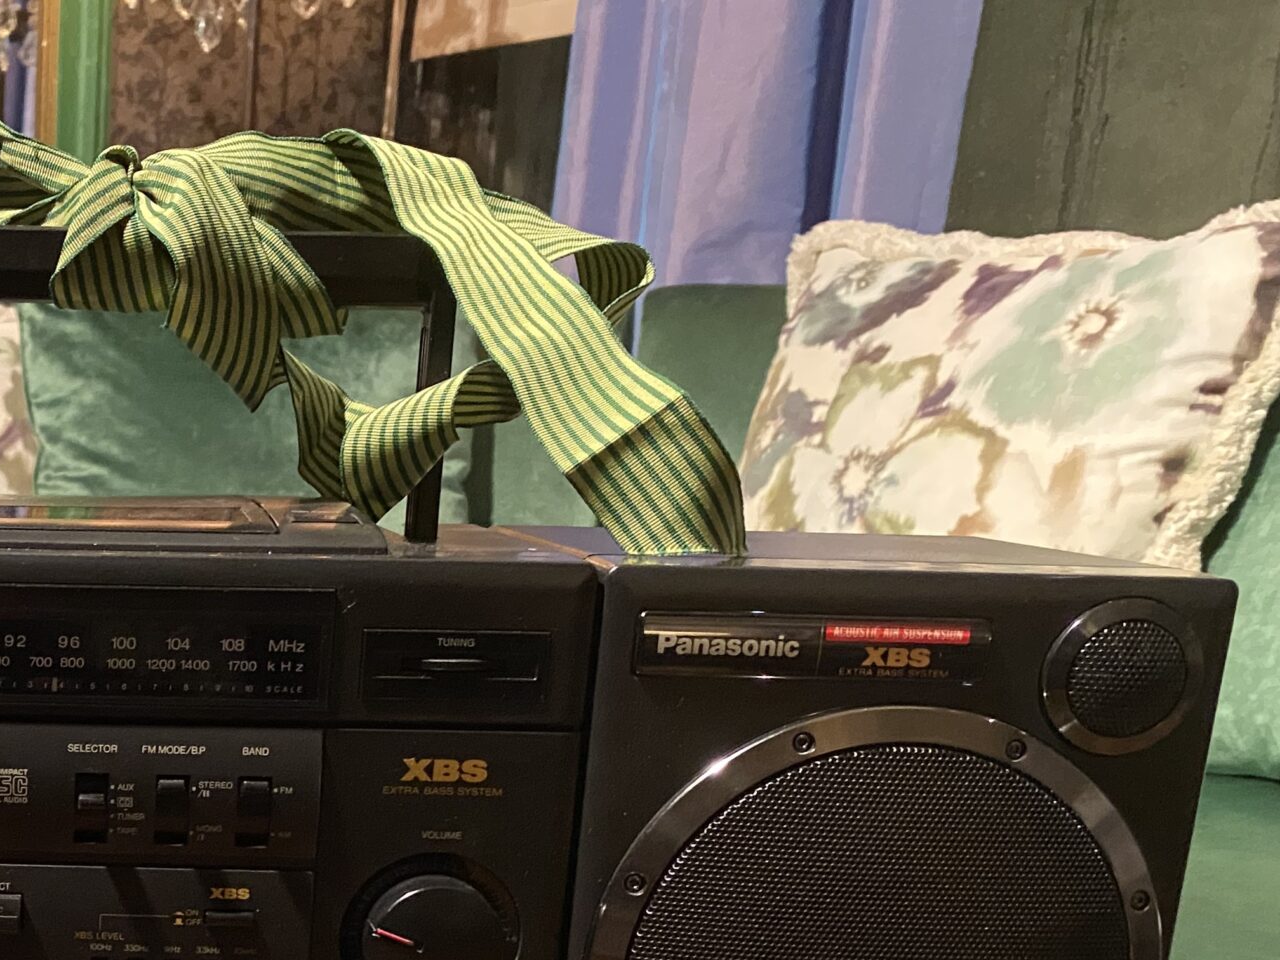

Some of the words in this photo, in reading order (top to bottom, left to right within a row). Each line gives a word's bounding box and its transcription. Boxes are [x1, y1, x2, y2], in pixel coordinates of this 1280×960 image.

[833, 626, 880, 638] ACOUSTIC
[883, 627, 900, 639] AIR
[903, 628, 964, 641] SUSPENSION
[4, 634, 26, 648] 92
[58, 635, 80, 649] 96
[112, 636, 137, 650] 100
[166, 637, 191, 651] 104
[221, 638, 245, 652] 108
[269, 639, 305, 653] MHz
[438, 637, 476, 648] TUNING
[657, 634, 800, 658] Panasonic
[861, 646, 931, 668] XBS
[29, 656, 53, 668] 700
[59, 657, 84, 669] 800
[107, 657, 136, 670] 1000
[146, 658, 176, 671] 1200
[181, 659, 210, 671] 1400
[228, 660, 257, 672] 1700
[838, 667, 872, 677] EXTRA
[267, 685, 303, 694] SCALE
[67, 744, 118, 754] SELECTOR
[142, 745, 157, 755] FM
[242, 747, 270, 757] BAND
[400, 757, 489, 783] XBS
[117, 783, 135, 792] AUX
[198, 780, 234, 790] STEREO
[279, 786, 294, 795] FM
[382, 785, 419, 795] EXTRA
[423, 786, 455, 796] BASS
[457, 787, 503, 797] SYSTEM
[4, 796, 28, 804] AUDIO
[421, 830, 463, 840] VOLUME
[209, 887, 251, 900] XBS
[74, 931, 94, 941] XBS
[96, 931, 125, 941] LEVEL
[89, 943, 113, 952] 100Hz
